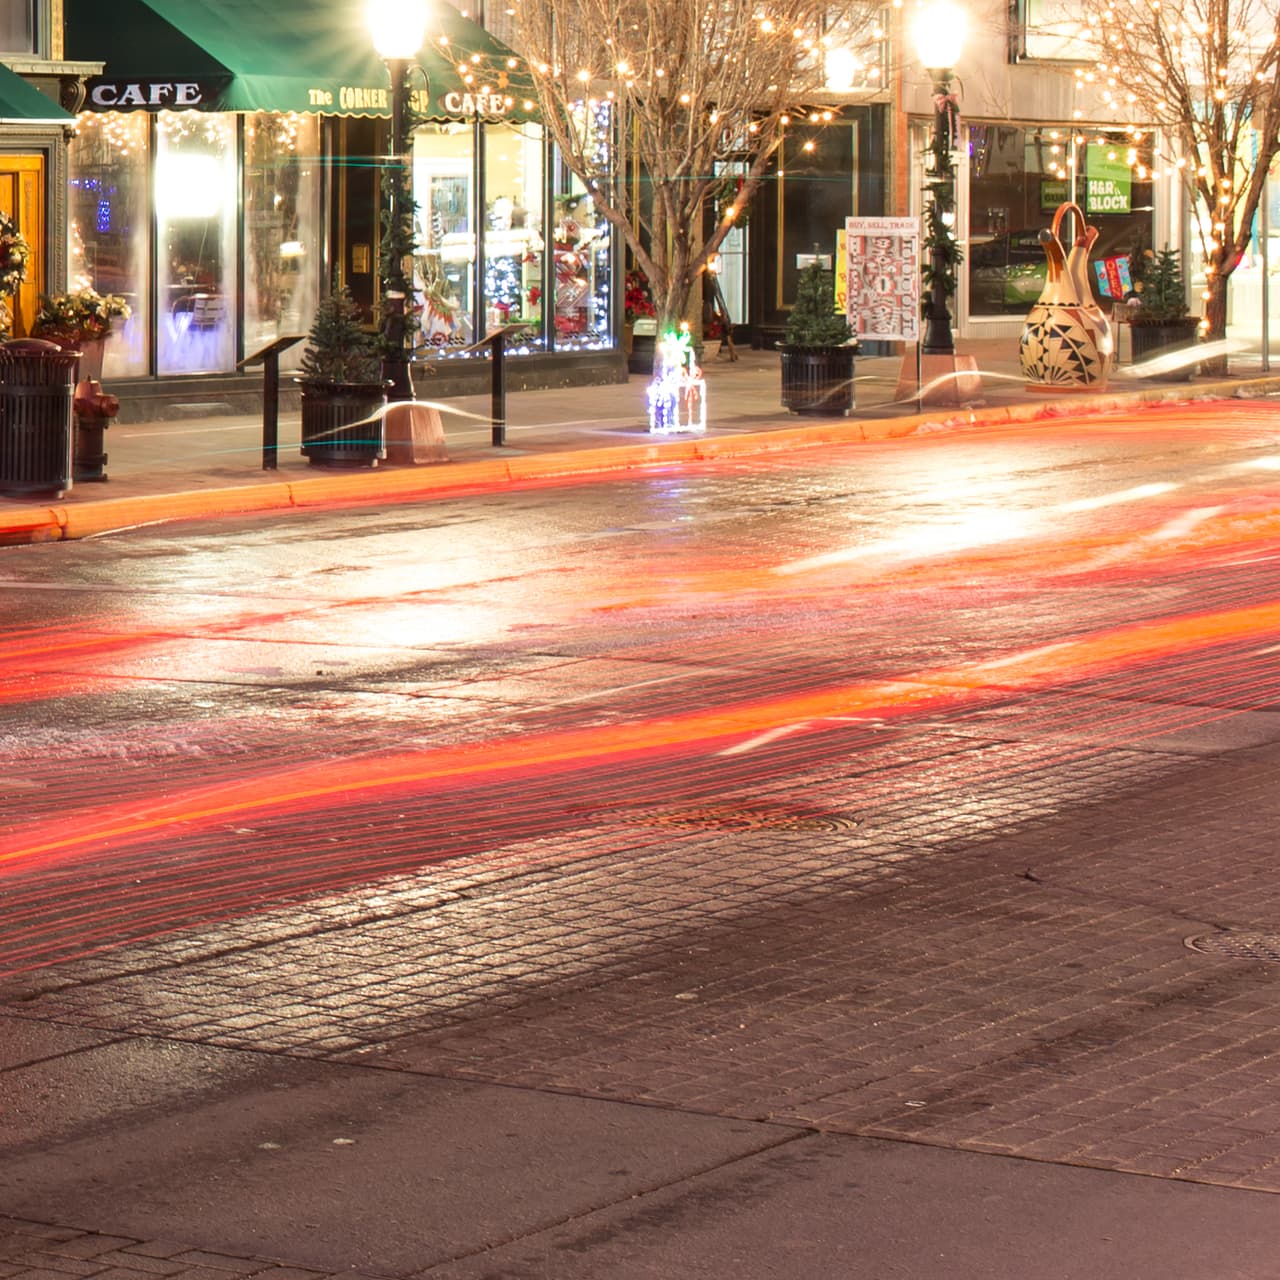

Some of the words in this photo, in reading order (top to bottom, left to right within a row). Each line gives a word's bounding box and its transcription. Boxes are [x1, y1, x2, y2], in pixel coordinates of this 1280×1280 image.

[91, 83, 202, 106] CAFE
[339, 86, 388, 110] CORNER
[444, 92, 505, 114] CAFE
[1088, 180, 1114, 195] H&R
[1089, 195, 1128, 210] BLOCK
[1106, 260, 1122, 297] OPEN
